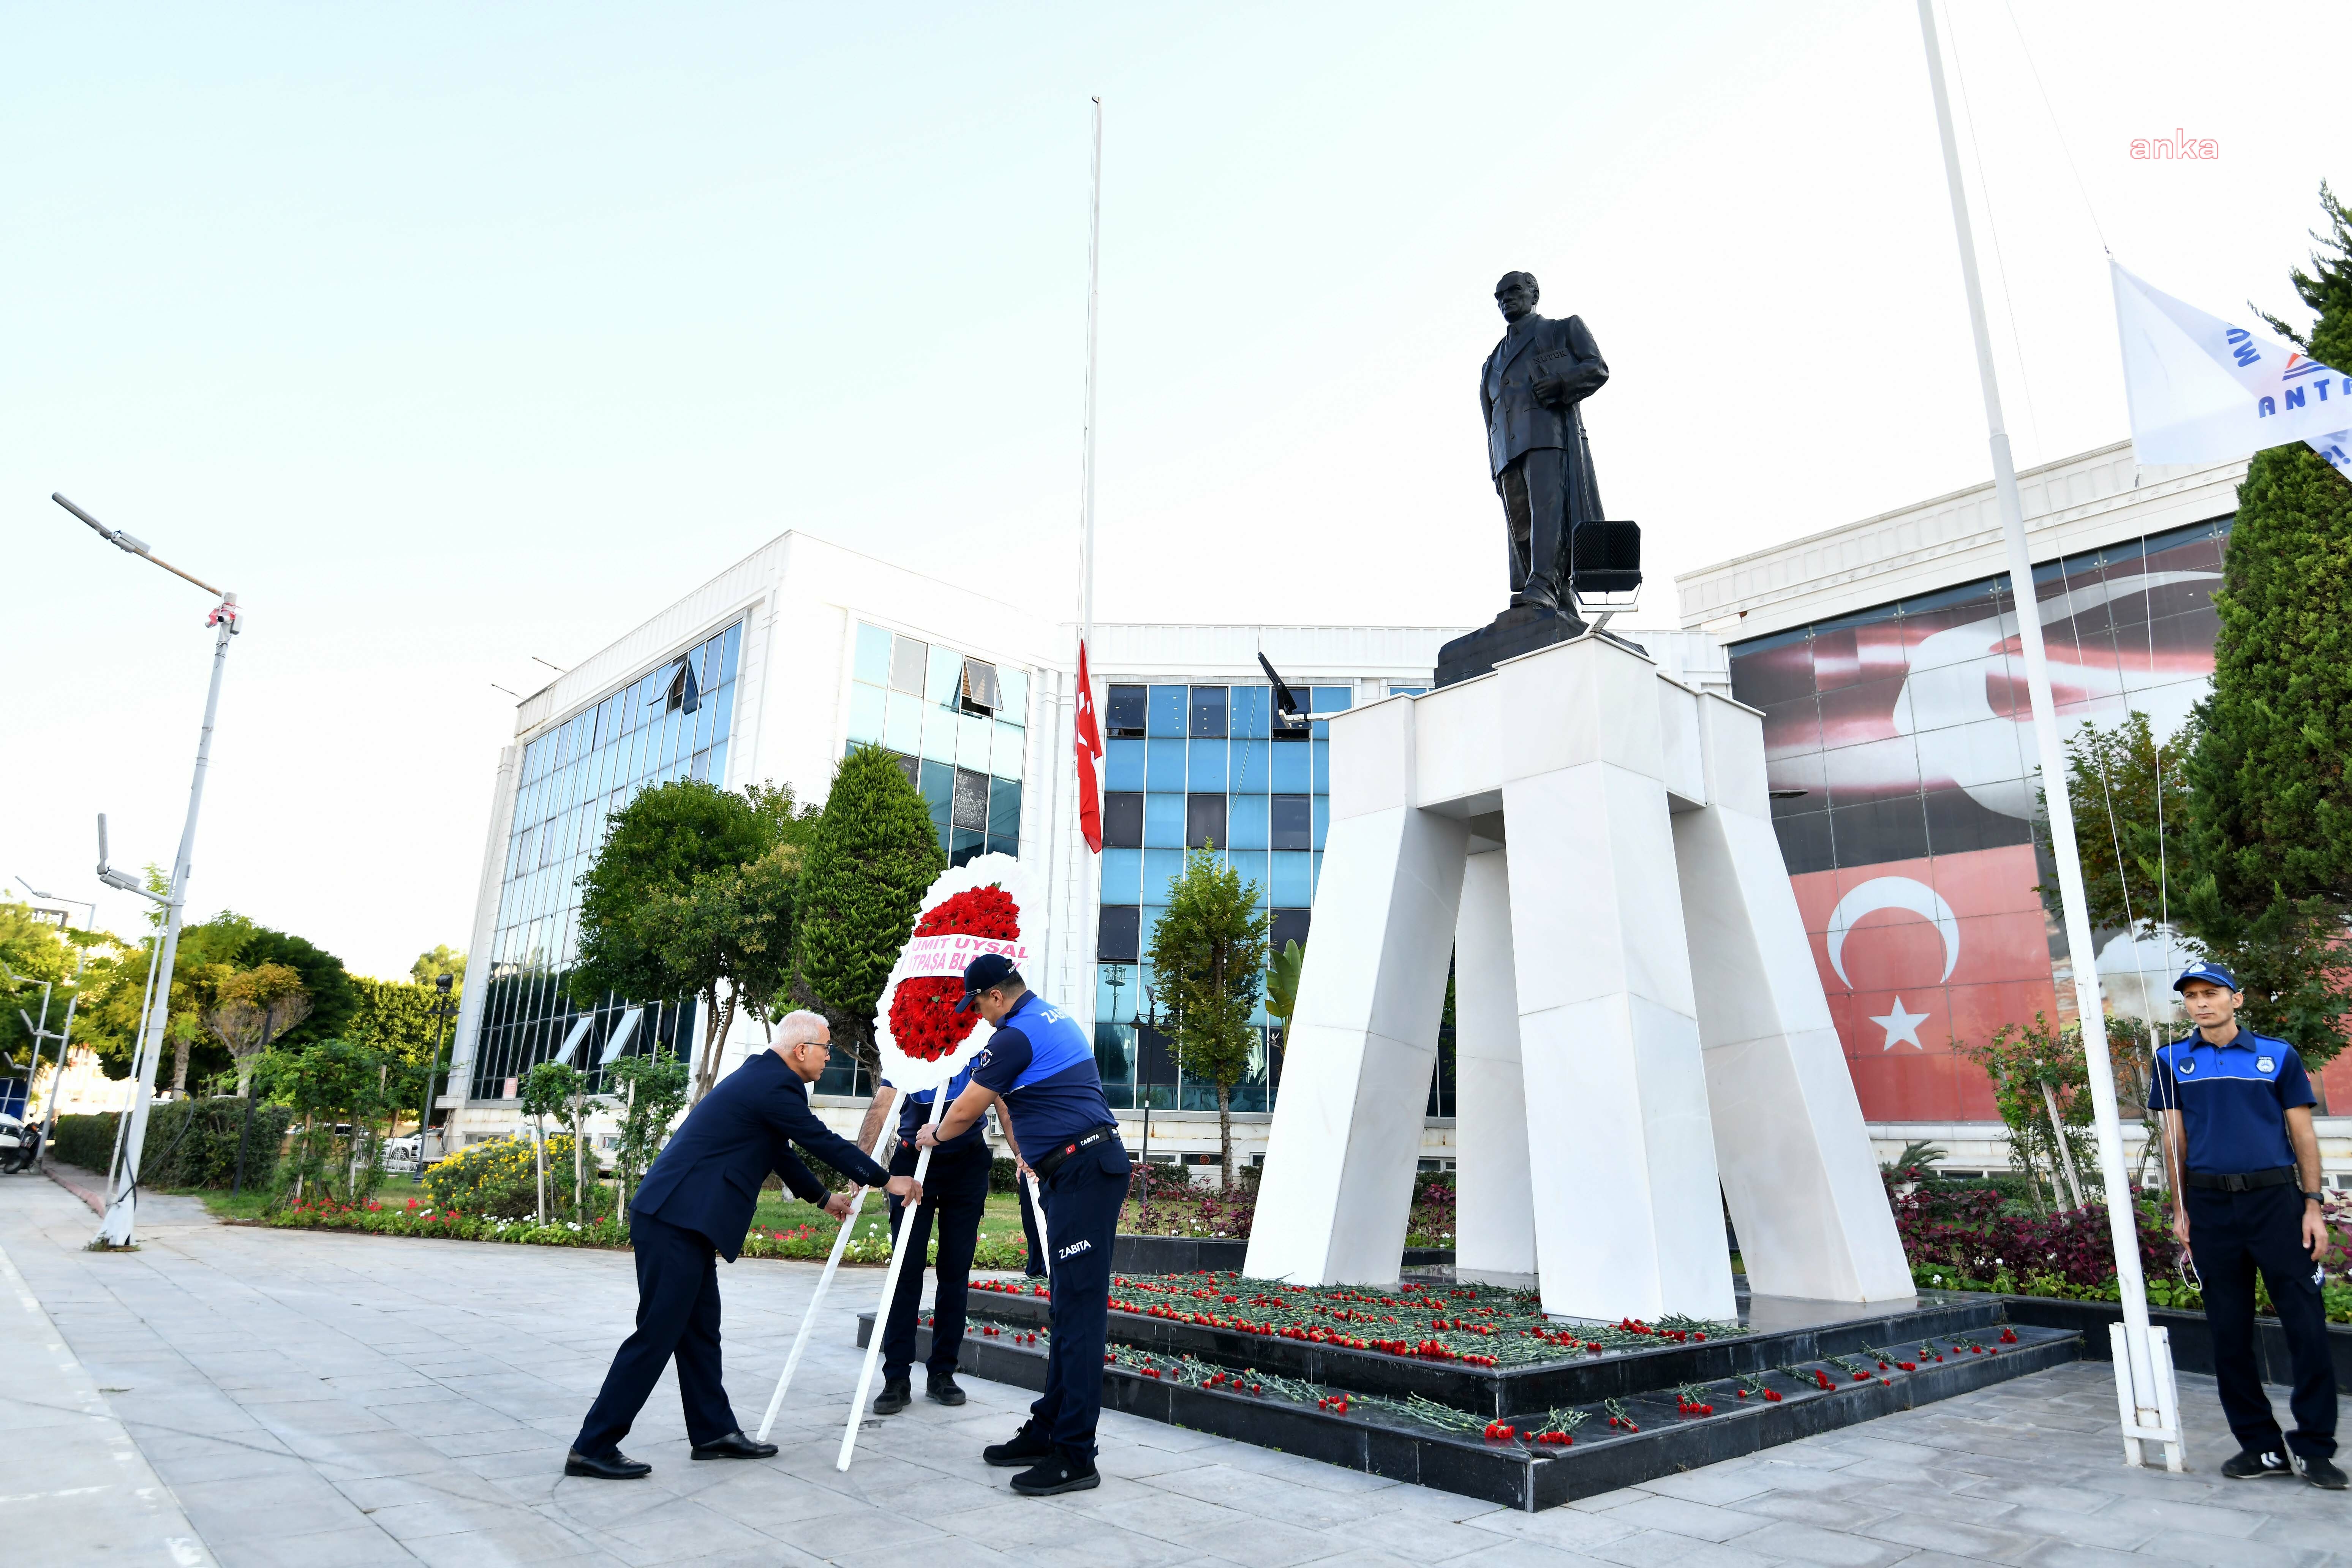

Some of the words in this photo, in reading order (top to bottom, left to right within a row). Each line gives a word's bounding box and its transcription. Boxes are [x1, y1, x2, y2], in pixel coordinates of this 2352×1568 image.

[1533, 351, 1567, 364] NUTUK
[912, 936, 950, 952] ÜMİT
[955, 937, 1029, 958] UYSAL
[1080, 1133, 1100, 1146] ZABITA
[1058, 1239, 1091, 1259] ZABITA
